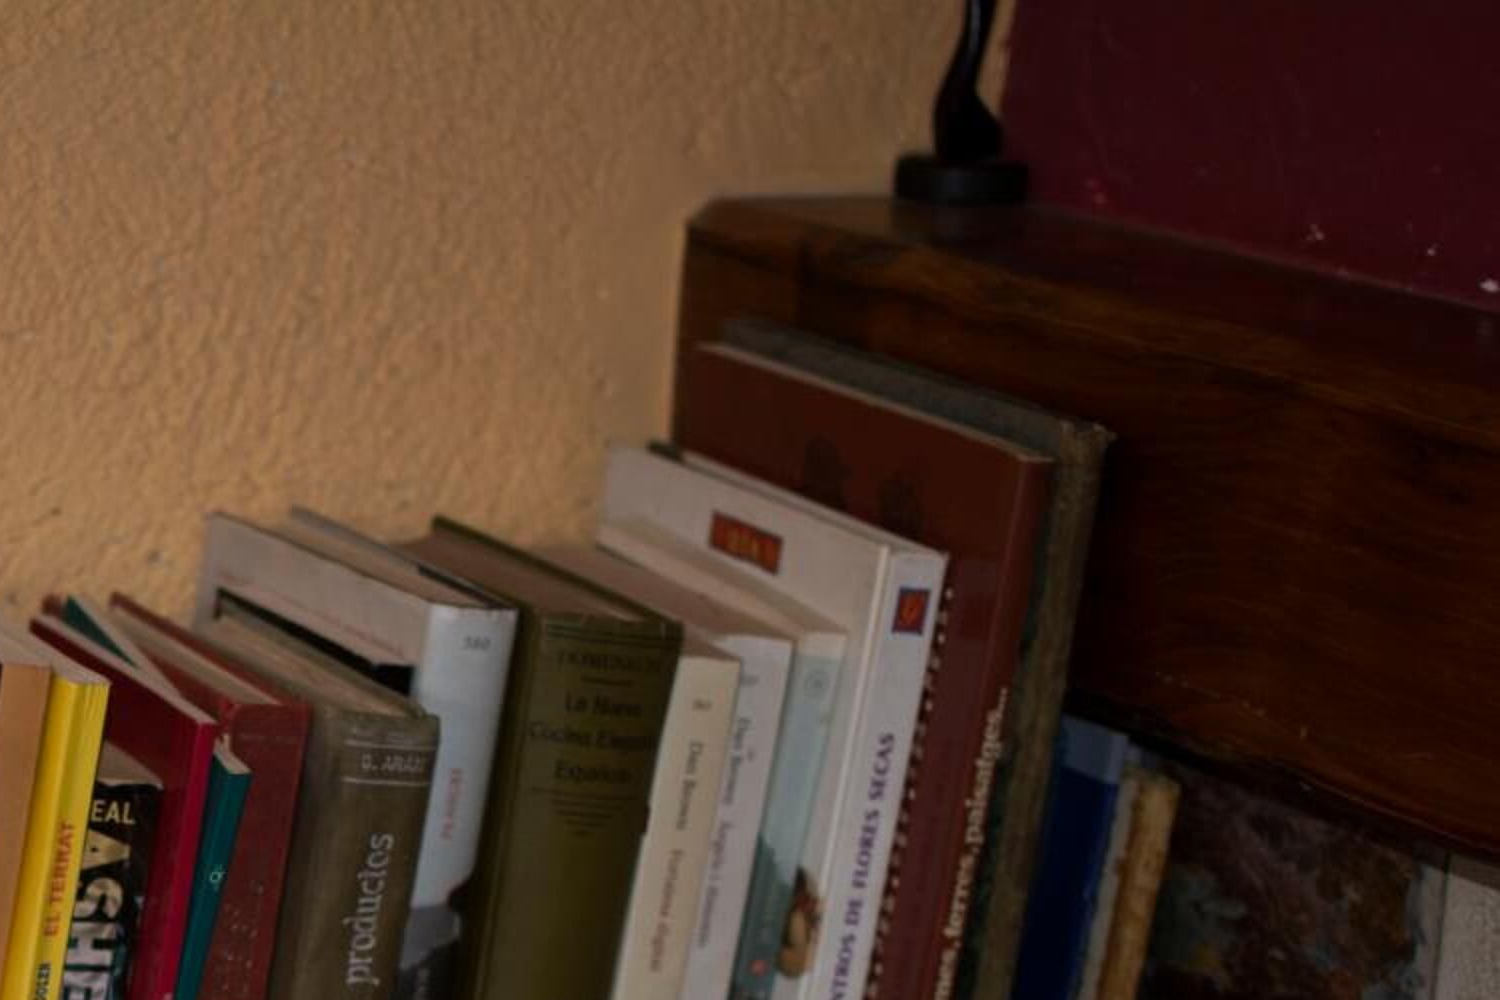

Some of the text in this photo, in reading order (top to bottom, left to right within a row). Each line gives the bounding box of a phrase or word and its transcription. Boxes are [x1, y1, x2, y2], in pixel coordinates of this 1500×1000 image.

[869, 733, 895, 801] SECAS
[91, 799, 135, 824] EAL
[852, 809, 880, 889] FLORES
[341, 833, 396, 986] productos
[845, 901, 863, 927] DE
